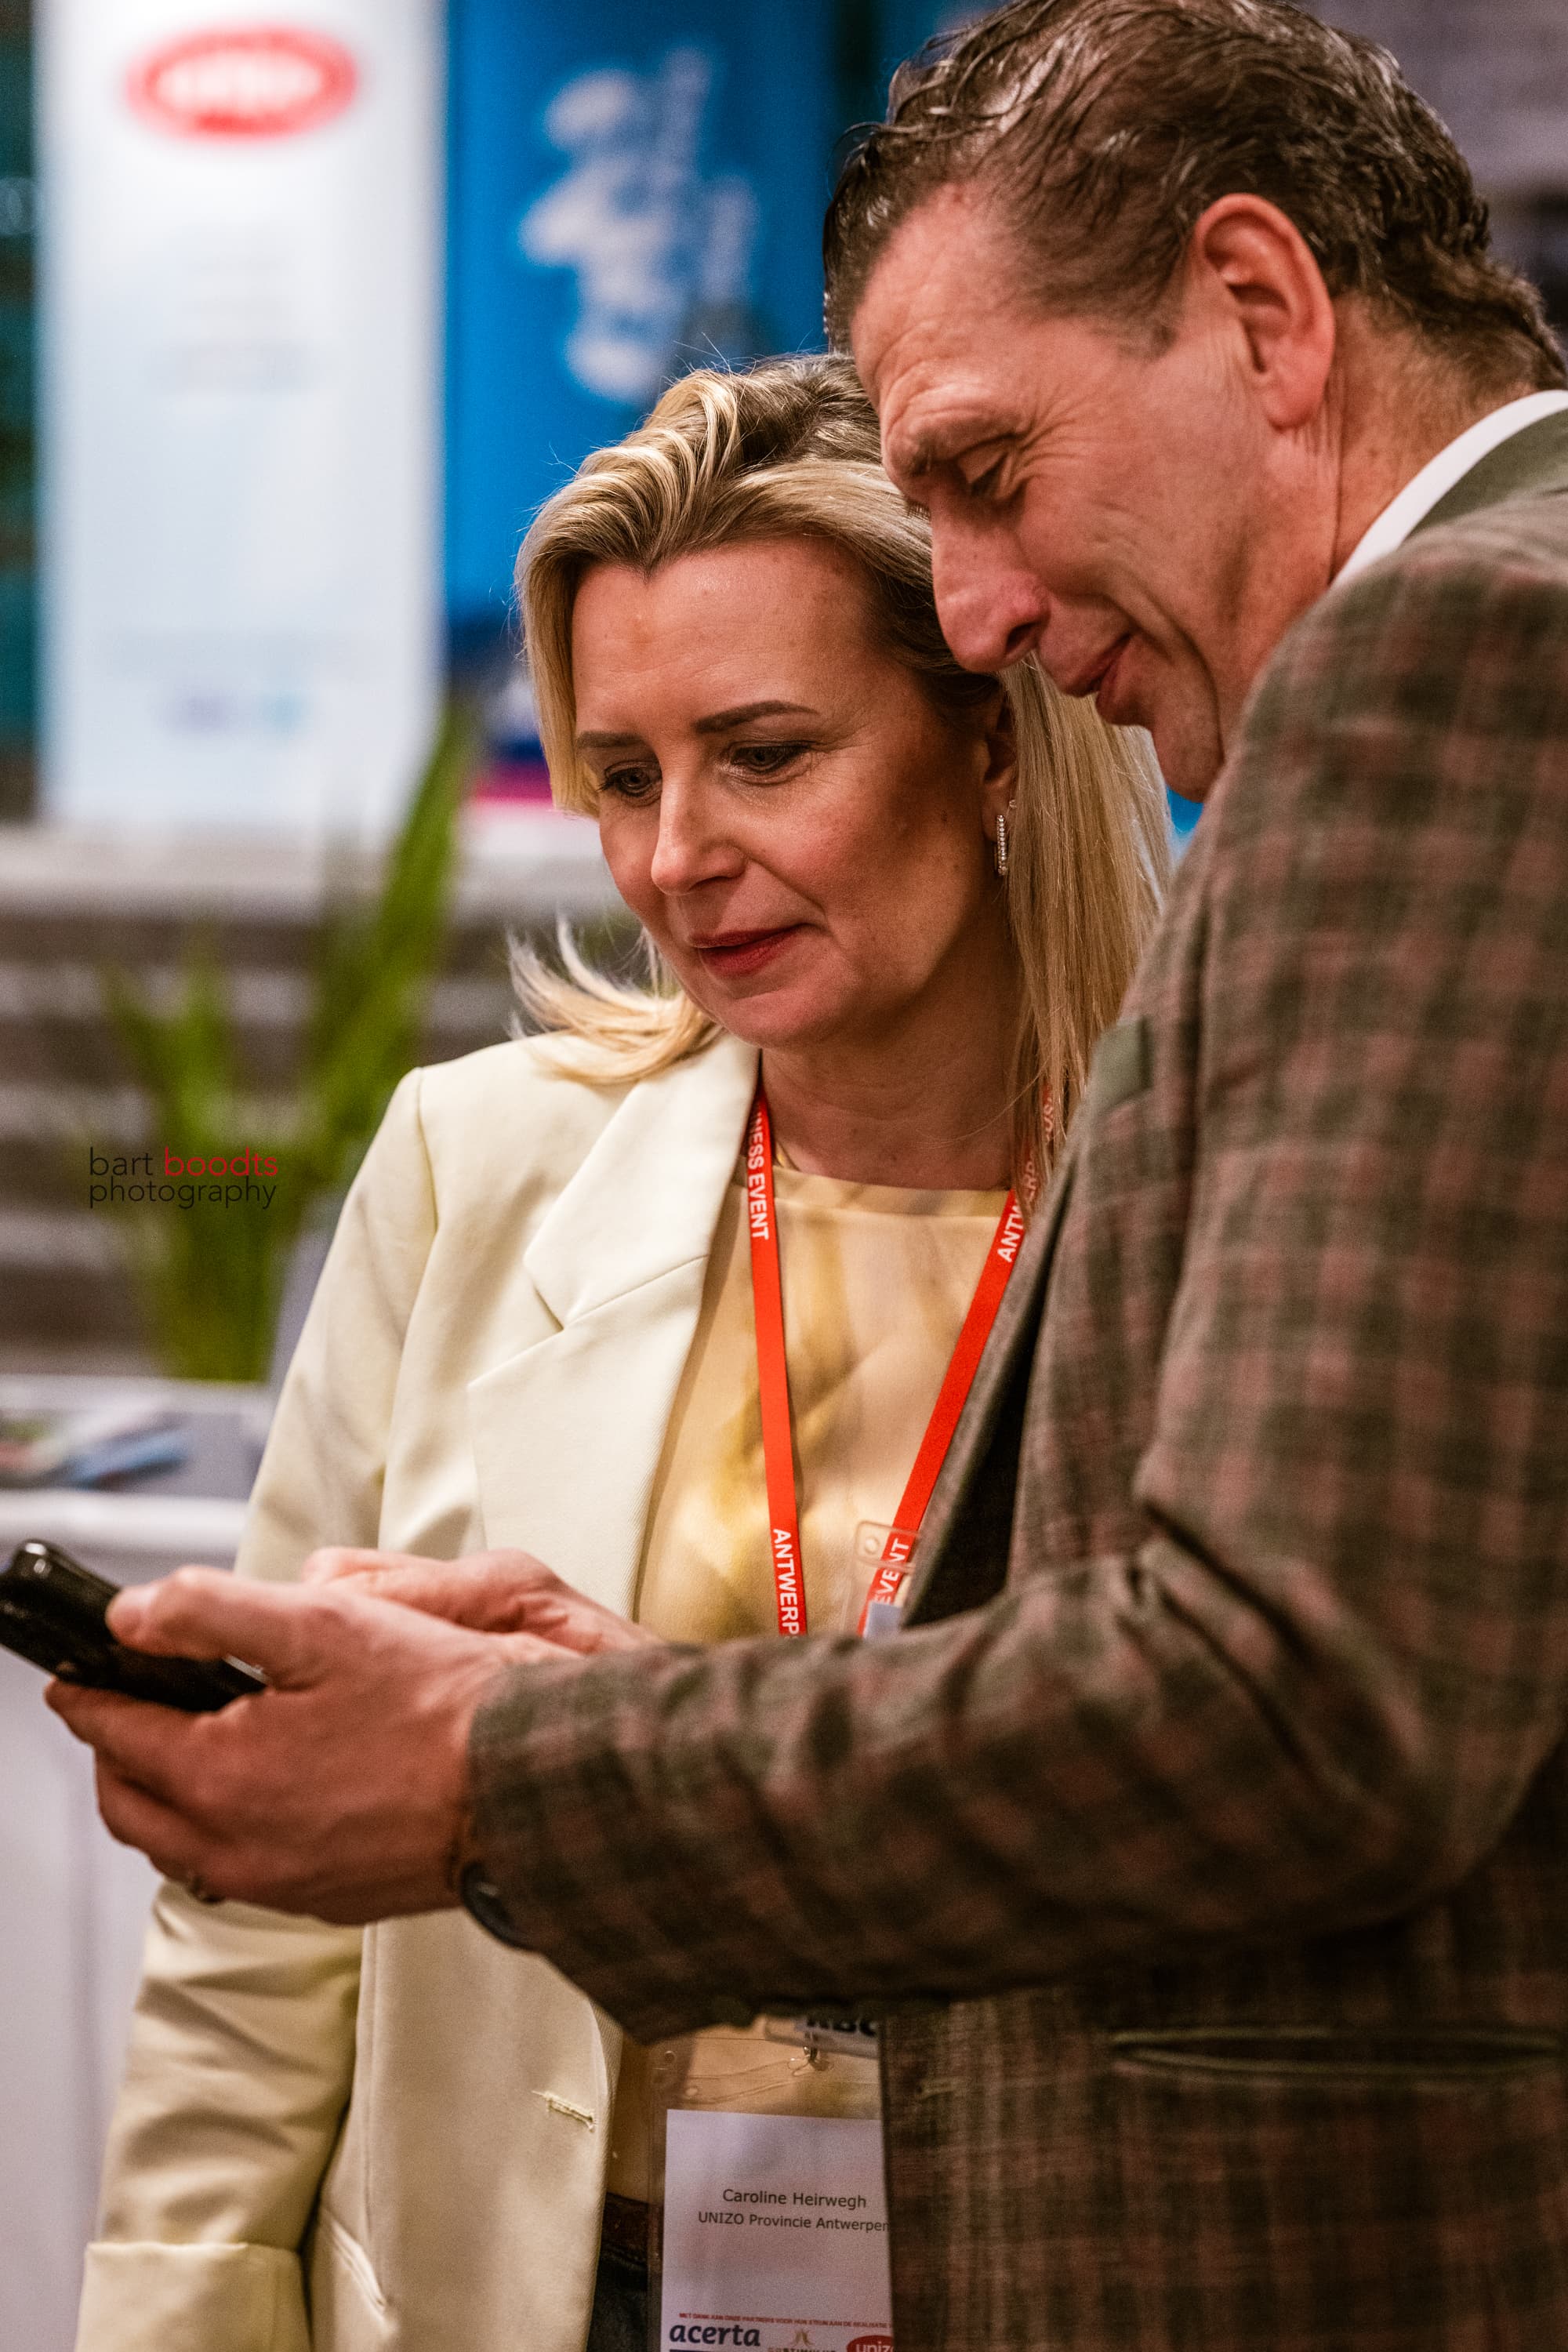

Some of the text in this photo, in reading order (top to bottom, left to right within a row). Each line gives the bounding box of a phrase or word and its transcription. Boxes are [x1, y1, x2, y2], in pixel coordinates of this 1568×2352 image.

[748, 1173, 769, 1240] EVENT
[773, 1529, 800, 1636] ANTWERP
[873, 1537, 909, 1605] EVENT
[698, 2212, 744, 2225] UNIZO
[750, 2214, 811, 2228] Provincie
[722, 2189, 867, 2210] Caroline Heirwegh
[670, 2324, 760, 2347] acerta
